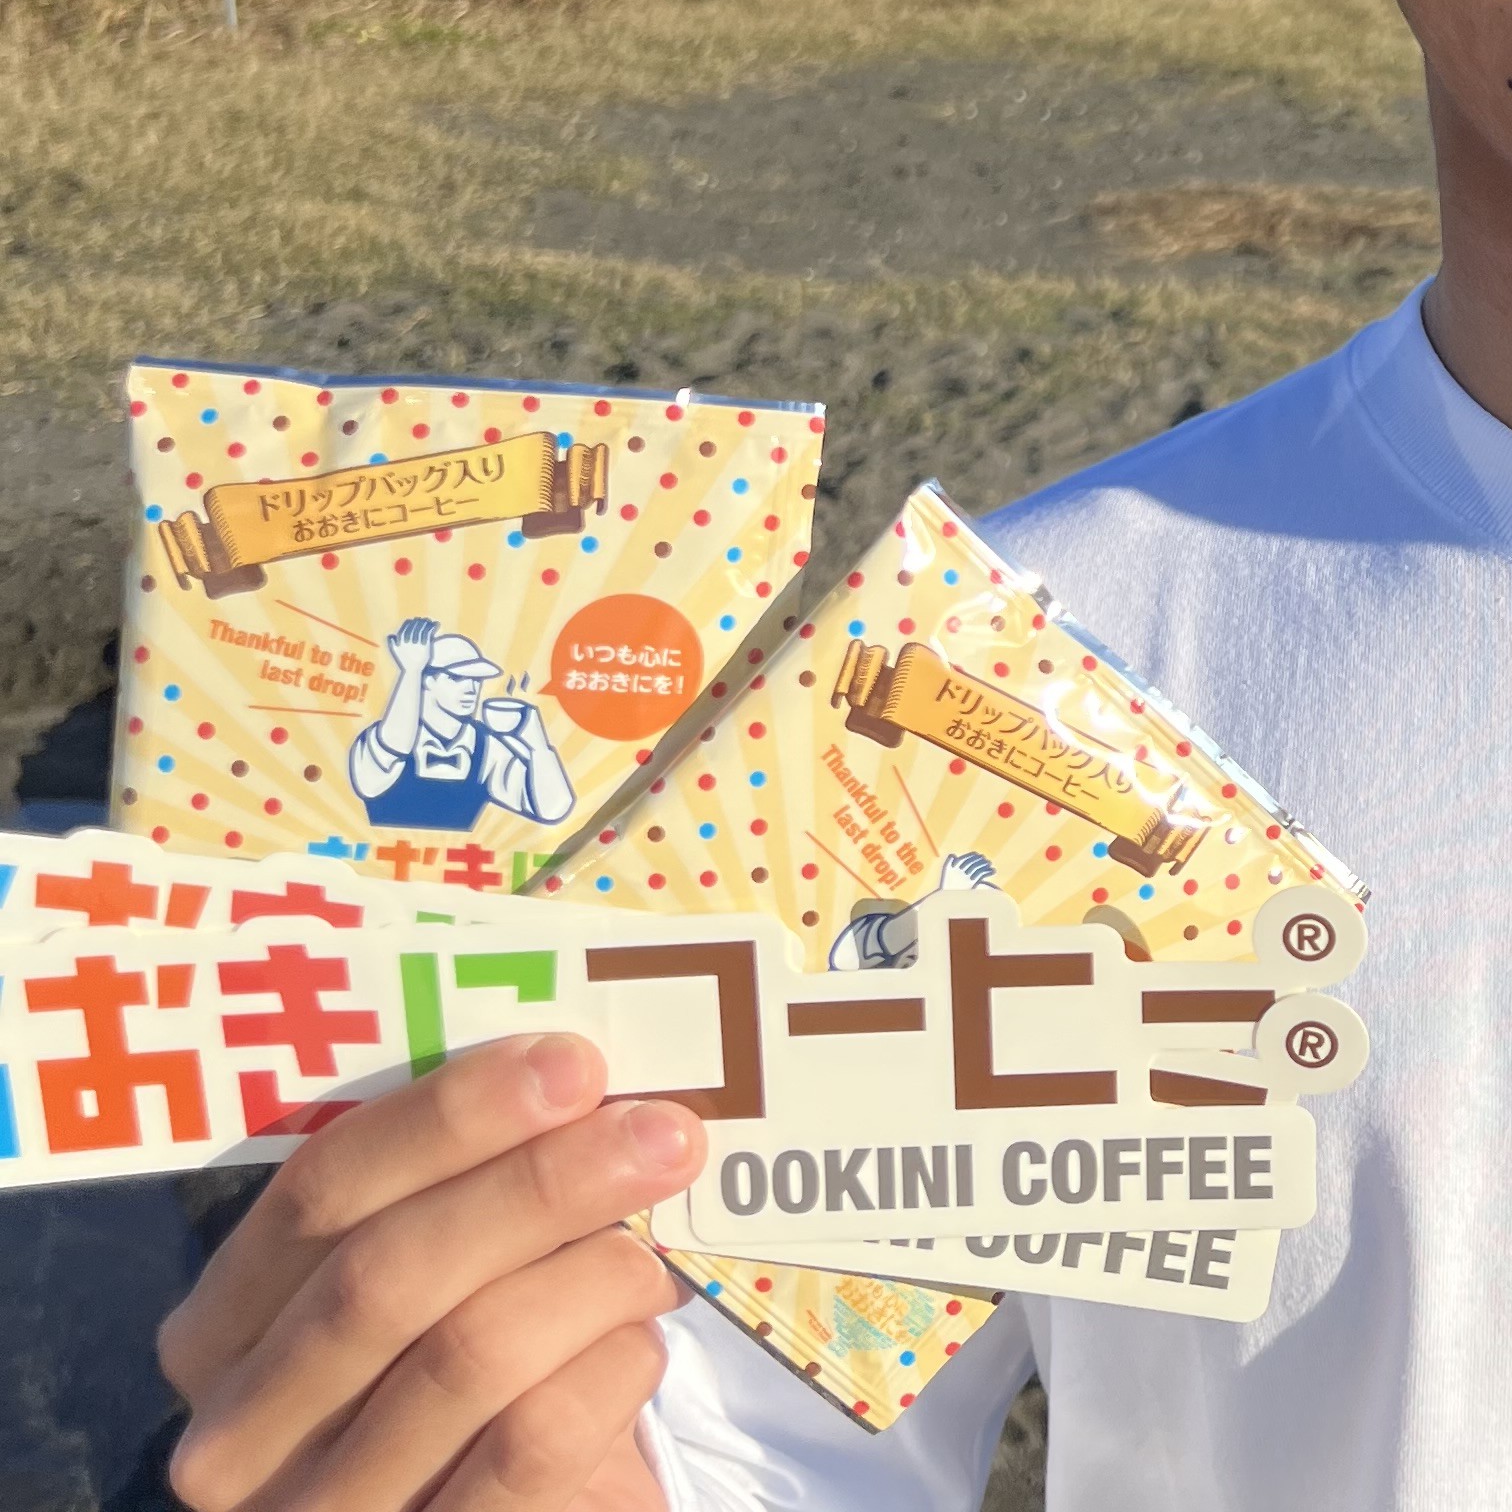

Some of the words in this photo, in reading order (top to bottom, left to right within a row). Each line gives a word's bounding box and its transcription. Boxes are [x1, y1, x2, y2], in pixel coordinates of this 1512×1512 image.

[259, 454, 505, 522] ドリップバッグ入り
[293, 496, 479, 543] おおきにコーヒー
[209, 618, 306, 660] Thankful
[311, 644, 333, 666] to
[339, 651, 376, 677] the
[259, 660, 304, 688] last
[308, 672, 369, 704] drop!
[573, 643, 682, 668] いつも心に
[945, 718, 1100, 801] おおきにコーヒー
[821, 743, 889, 825] Thankful
[880, 820, 901, 844] to
[896, 841, 924, 876] the
[832, 804, 870, 845] last
[861, 842, 907, 892] drop!
[0, 918, 1276, 1159] おきにコーヒー
[720, 1143, 976, 1216] OOKINI
[1001, 1135, 1275, 1208] COFFEE
